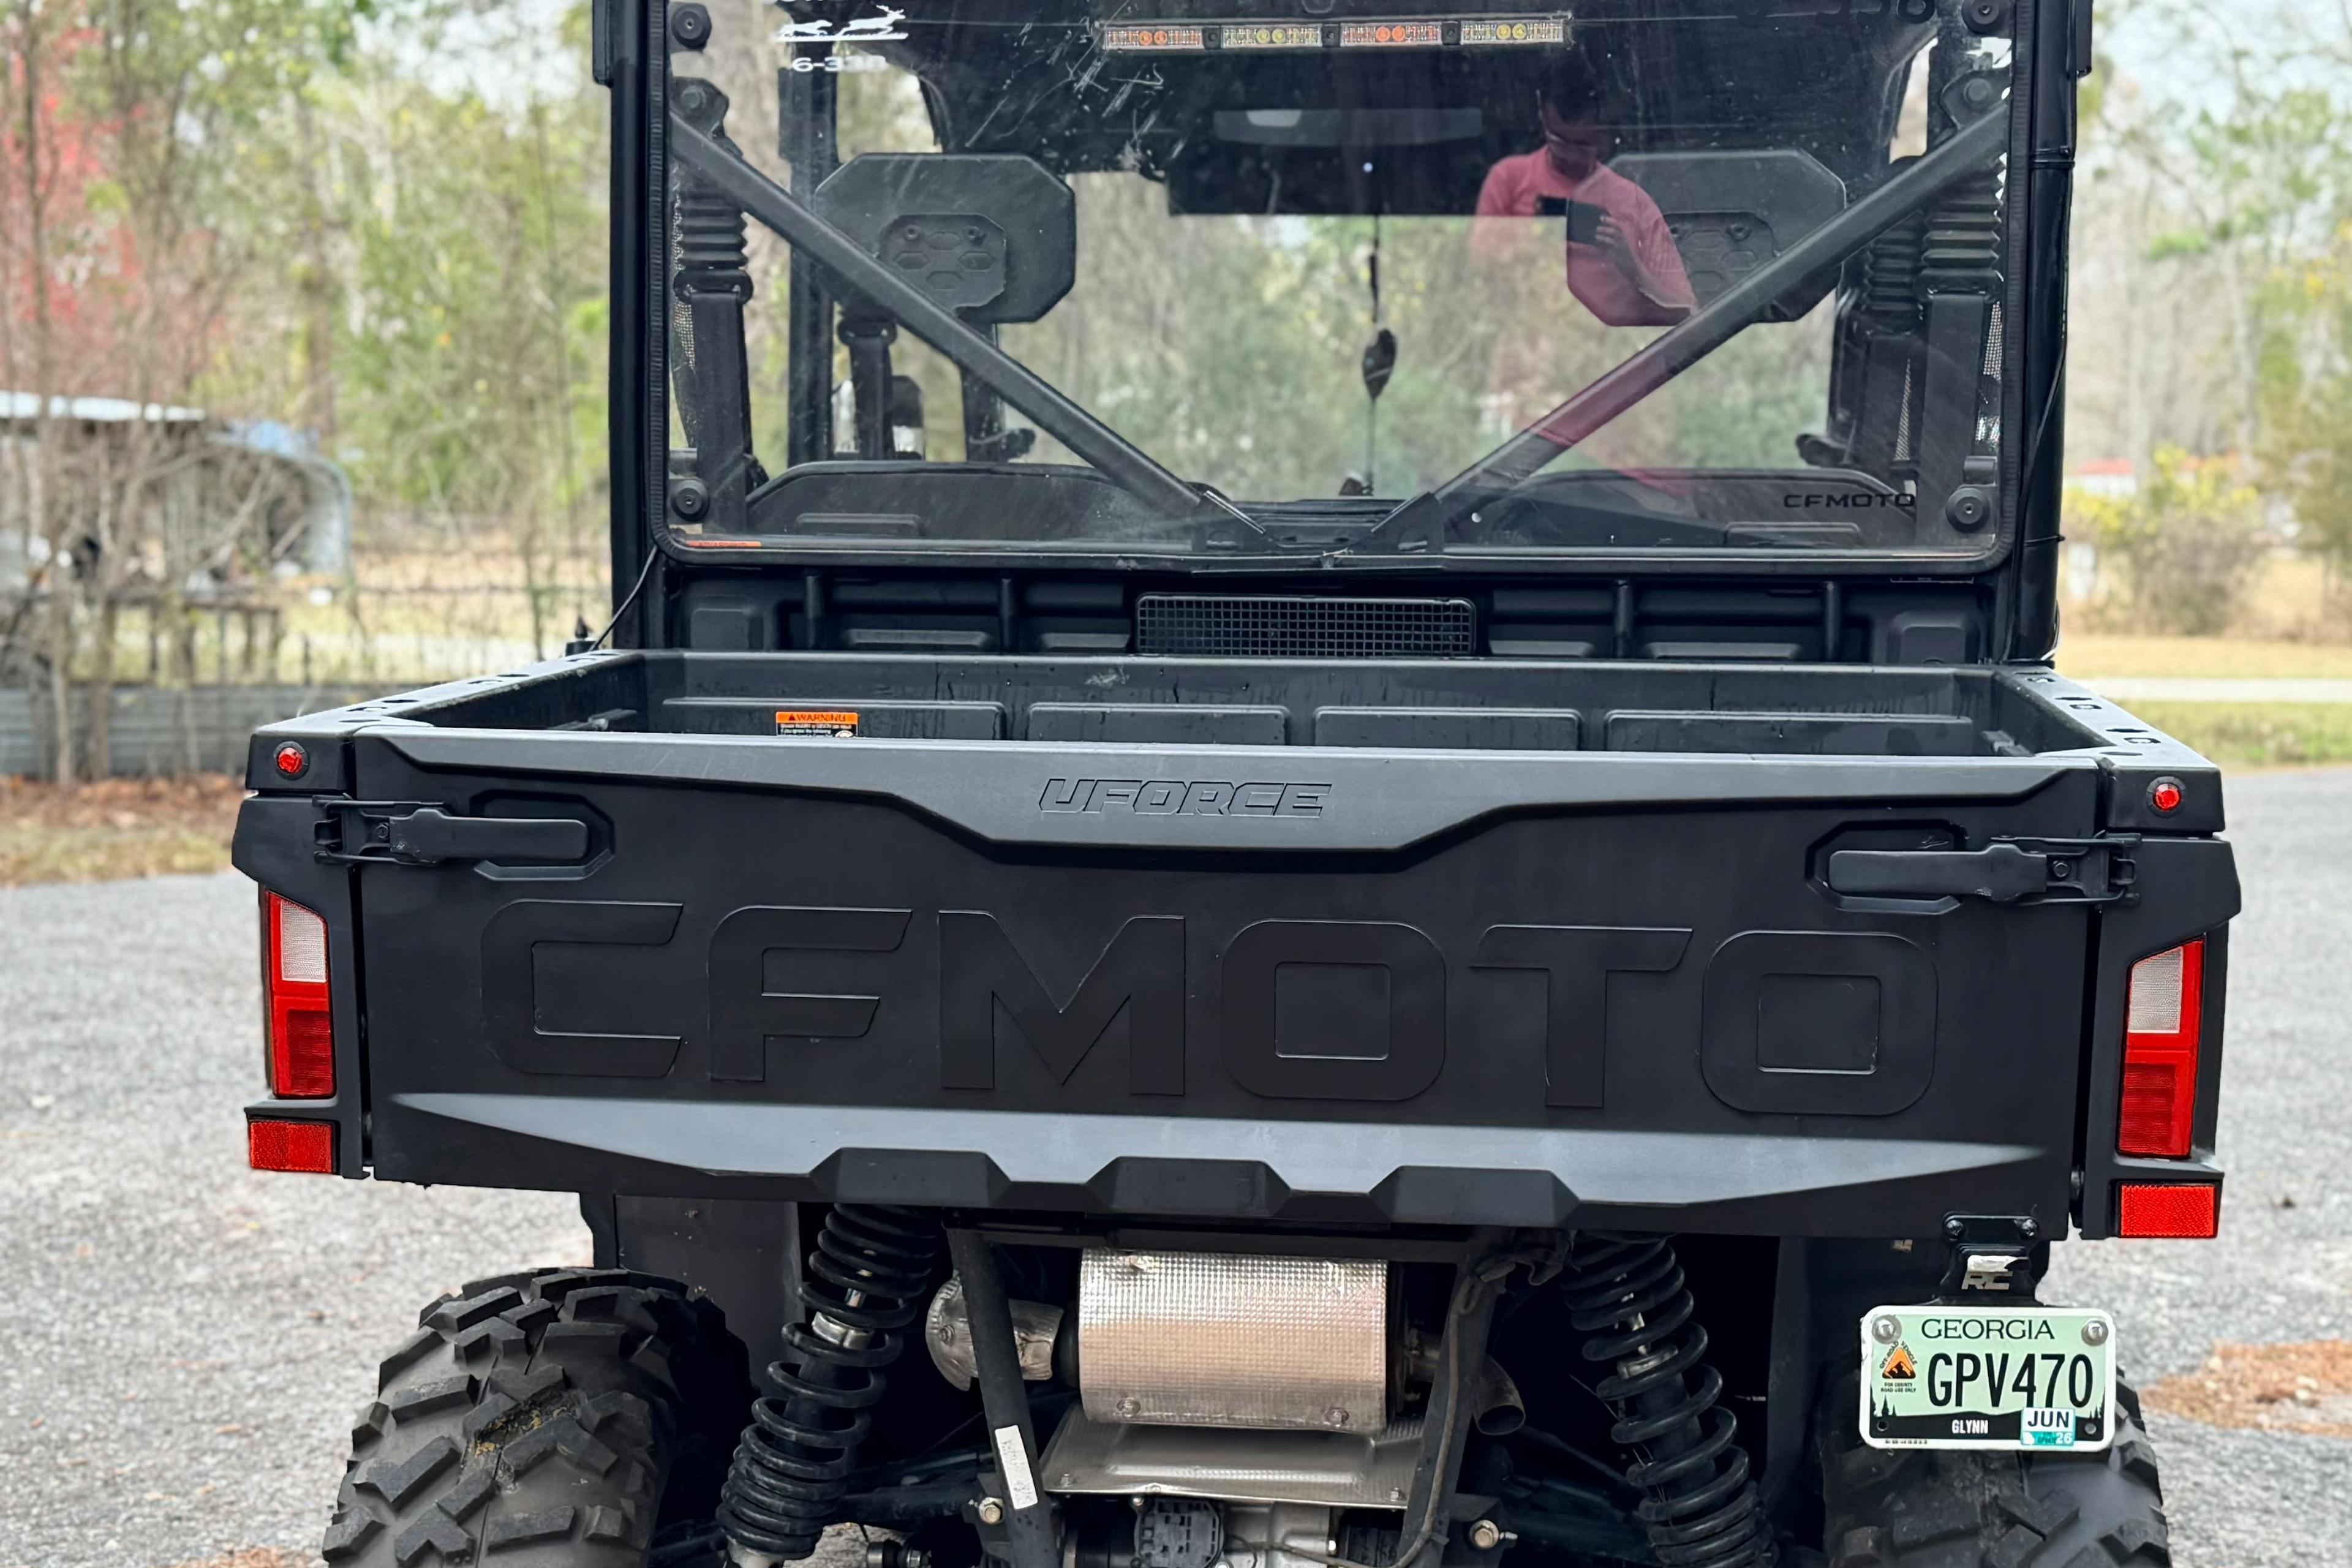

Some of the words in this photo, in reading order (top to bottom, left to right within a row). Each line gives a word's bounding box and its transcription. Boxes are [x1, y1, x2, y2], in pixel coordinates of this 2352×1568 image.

[1784, 494, 1916, 508] CFMOTO
[1038, 778, 1333, 818] UFORCE
[481, 898, 1939, 1115] CFMOTO
[1961, 1271, 2013, 1291] RC
[1921, 1319, 2055, 1340] GEORGIA
[1928, 1352, 2094, 1408] GPV470
[1951, 1419, 1989, 1434] GLYNN
[2027, 1411, 2069, 1428] JUN
[2056, 1432, 2073, 1444] 26
